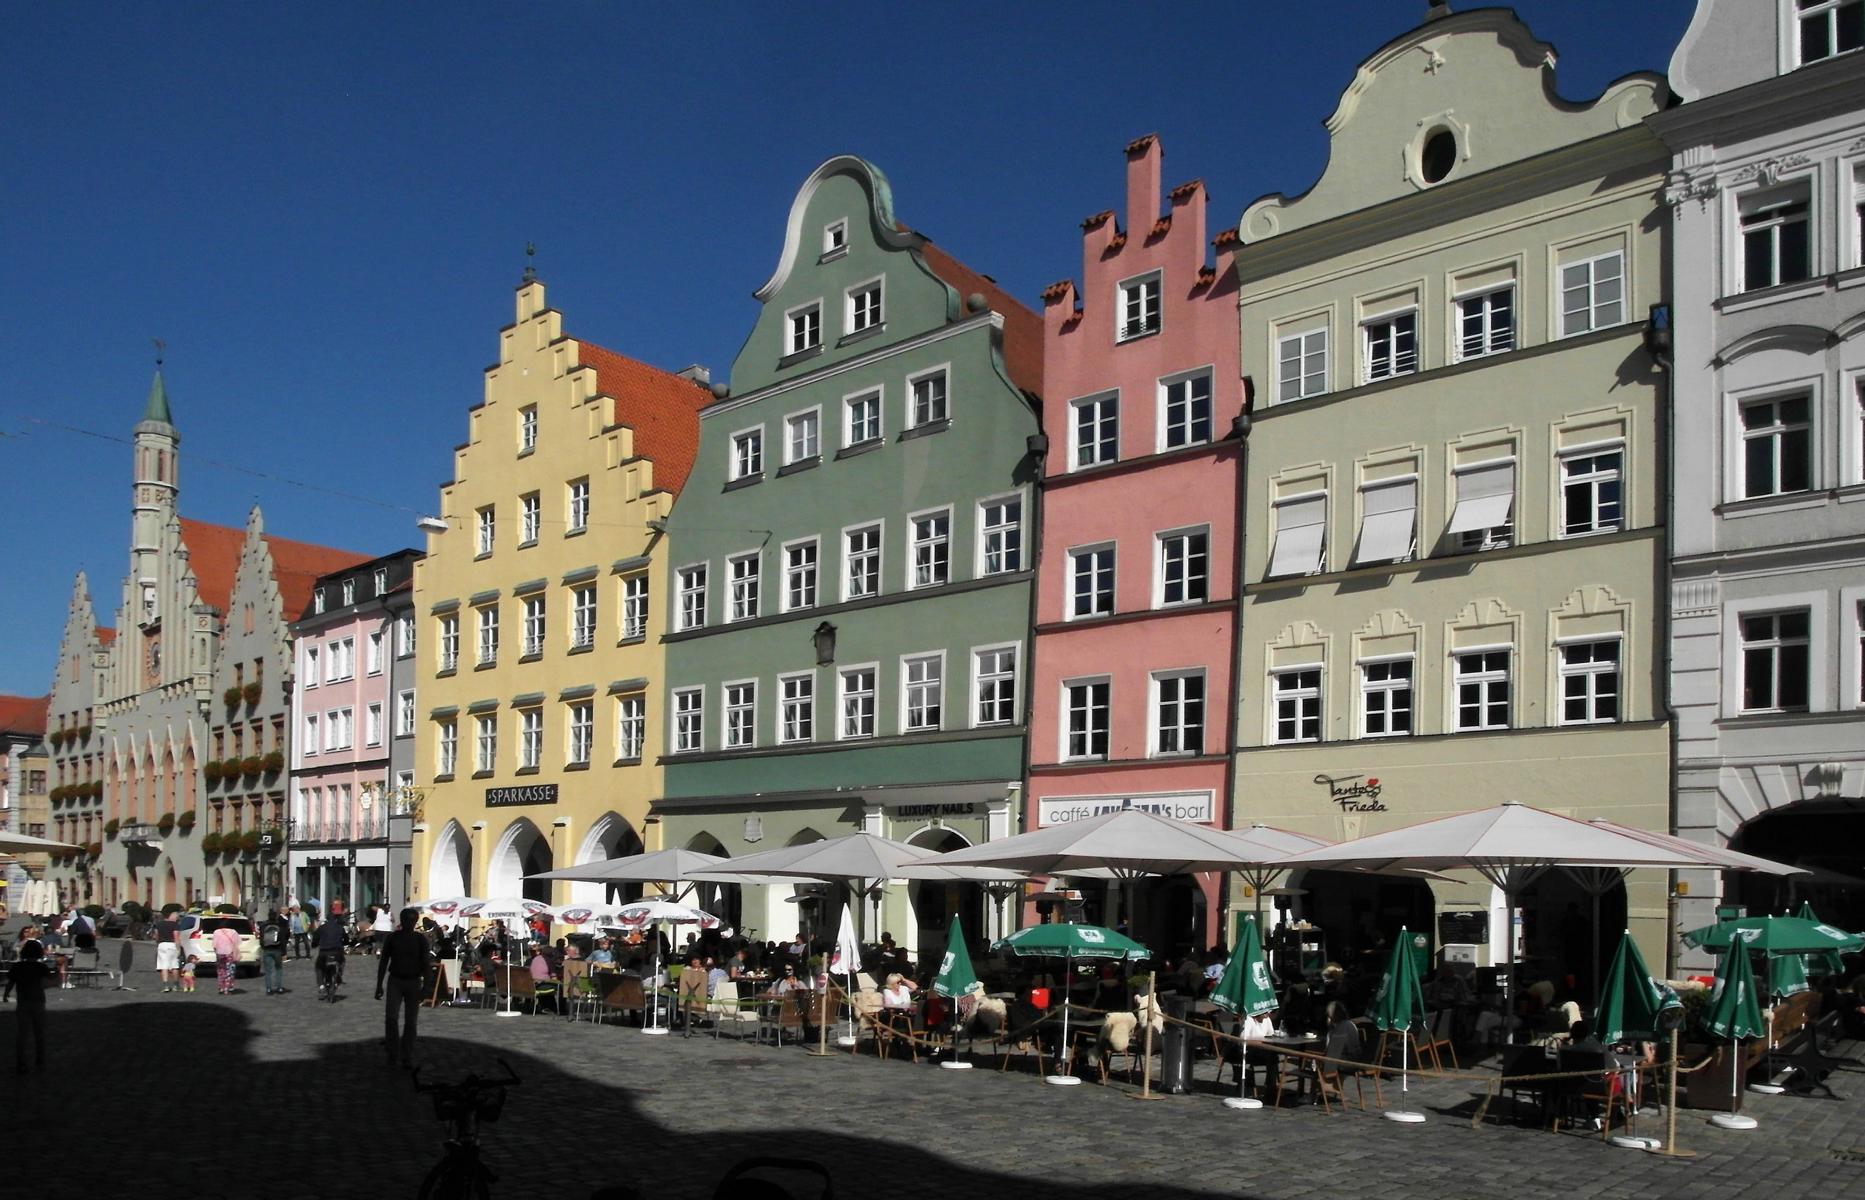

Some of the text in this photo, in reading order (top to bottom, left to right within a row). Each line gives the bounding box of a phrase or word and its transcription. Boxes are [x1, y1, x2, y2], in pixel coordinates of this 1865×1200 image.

[491, 786, 551, 803] SPARKASSE
[1314, 774, 1370, 798] Tante
[898, 802, 974, 817] LUXURY NAILS
[1333, 795, 1389, 812] Frieda
[1050, 807, 1090, 822] caffé
[1175, 804, 1205, 819] bar
